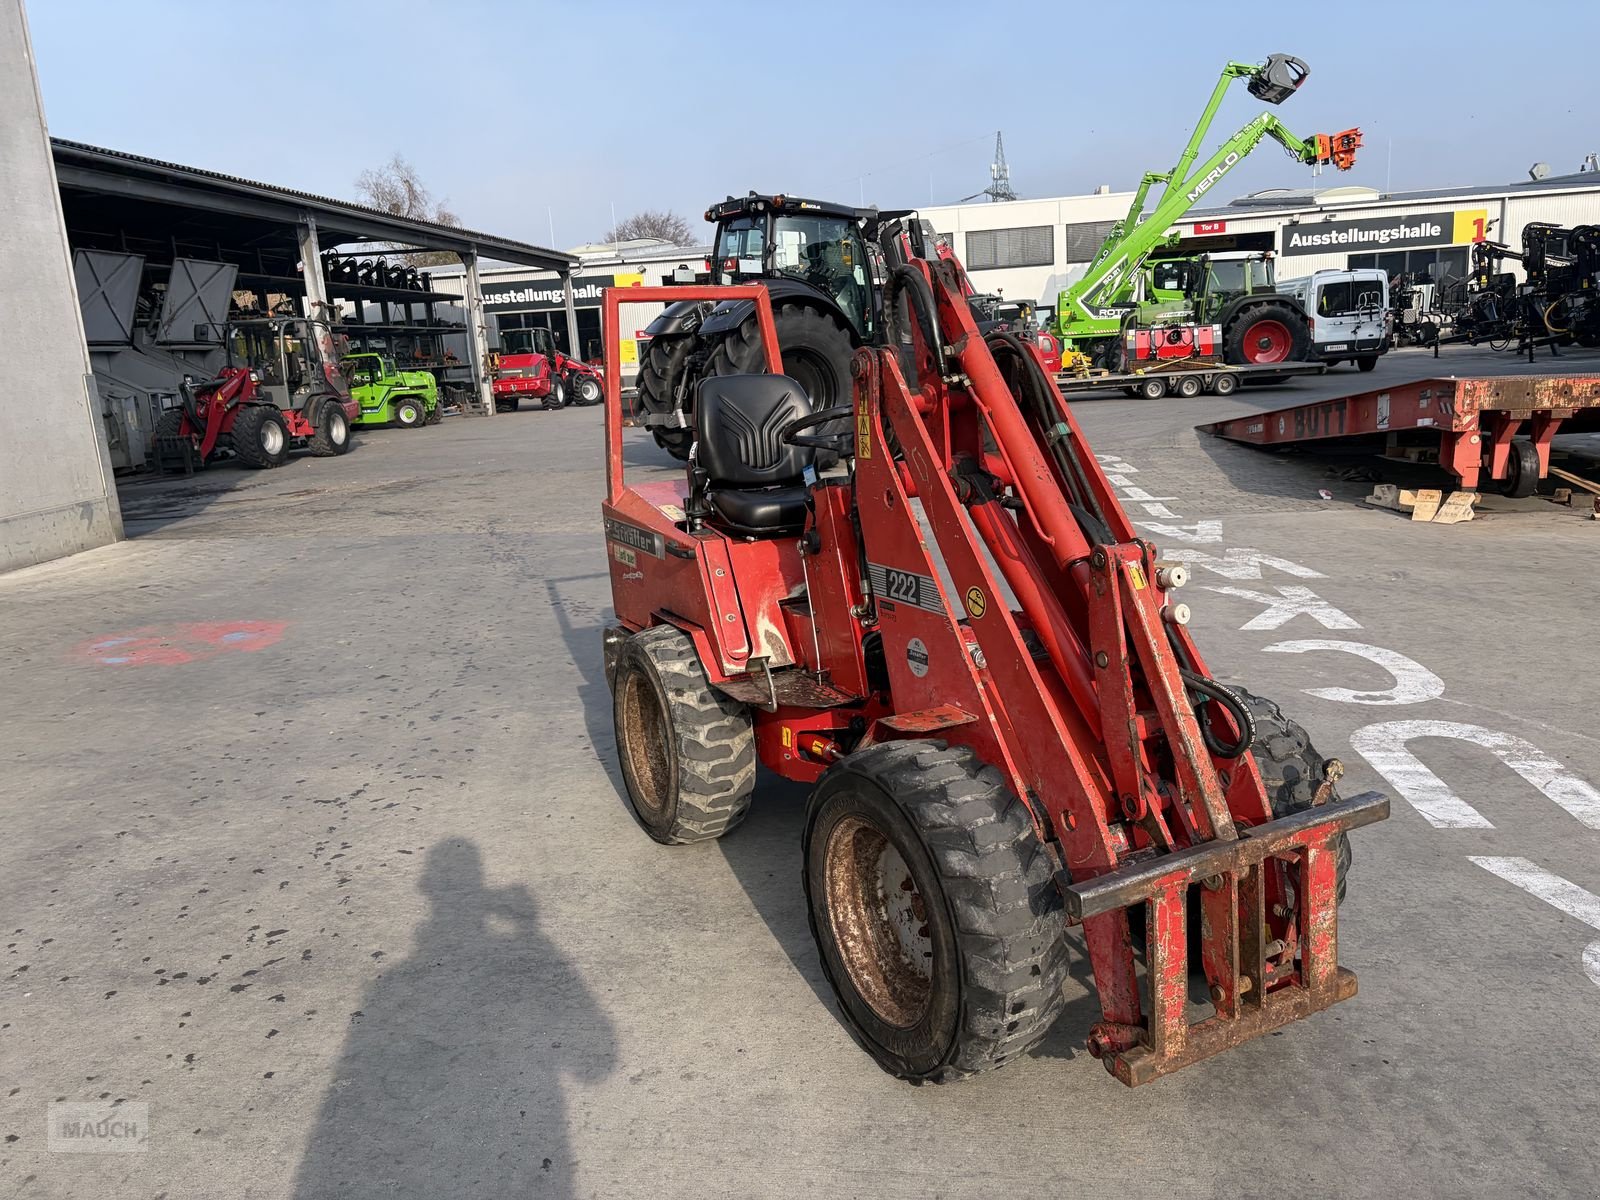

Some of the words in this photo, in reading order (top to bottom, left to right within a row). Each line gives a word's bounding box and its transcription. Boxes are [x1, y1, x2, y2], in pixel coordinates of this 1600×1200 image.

[1187, 151, 1240, 203] MERLO
[1201, 223, 1213, 231] Tor
[1289, 222, 1442, 248] Ausstellungshalle
[1471, 217, 1486, 242] 1
[1295, 400, 1347, 438] BUTT
[888, 571, 917, 604] 222
